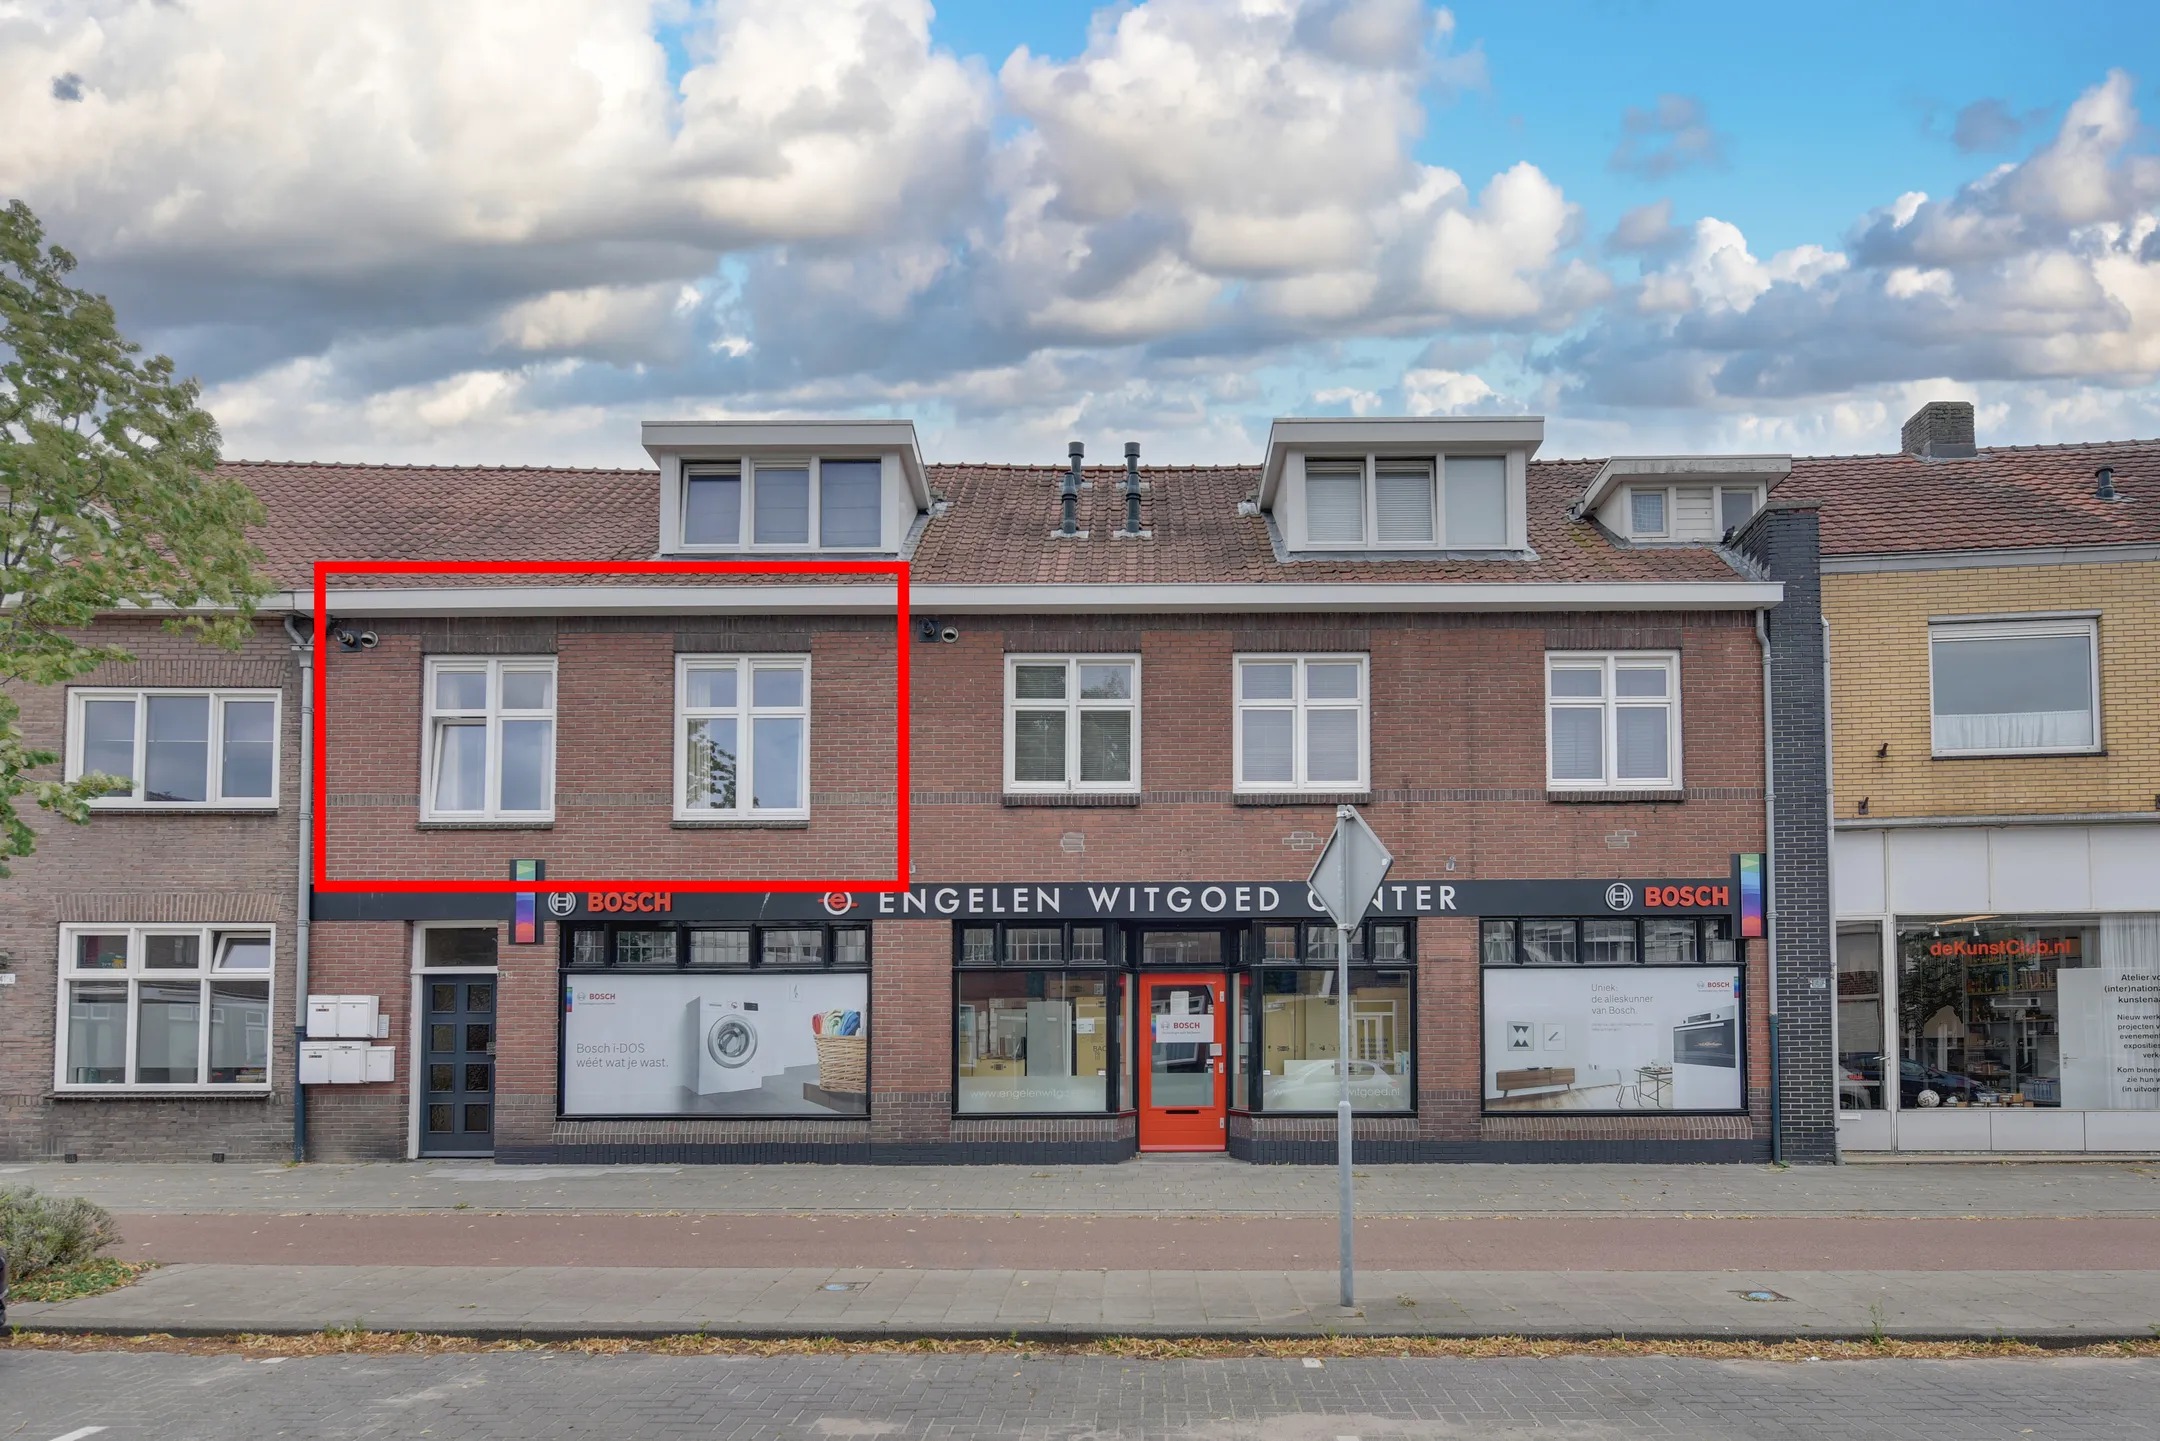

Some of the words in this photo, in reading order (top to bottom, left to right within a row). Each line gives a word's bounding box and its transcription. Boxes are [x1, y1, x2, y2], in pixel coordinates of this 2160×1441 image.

[587, 891, 672, 912] BOSCH
[879, 887, 1060, 913] ENGELEN
[1087, 886, 1280, 912] WITGOED
[1307, 885, 1457, 912] CNTER
[1645, 886, 1729, 907] BOSCH
[1930, 938, 2071, 956] deKunstClub.nl
[1591, 983, 1618, 992] Uniek:
[2104, 985, 2160, 993] (inter)nation
[1591, 994, 1602, 1003] de
[1604, 994, 1653, 1003] alleskunner
[1591, 1007, 1606, 1015] van
[577, 1043, 610, 1053] Bosch
[613, 1043, 645, 1053] i-DOS
[606, 1058, 625, 1068] wat
[627, 1057, 638, 1070] je
[640, 1058, 669, 1068] wast.
